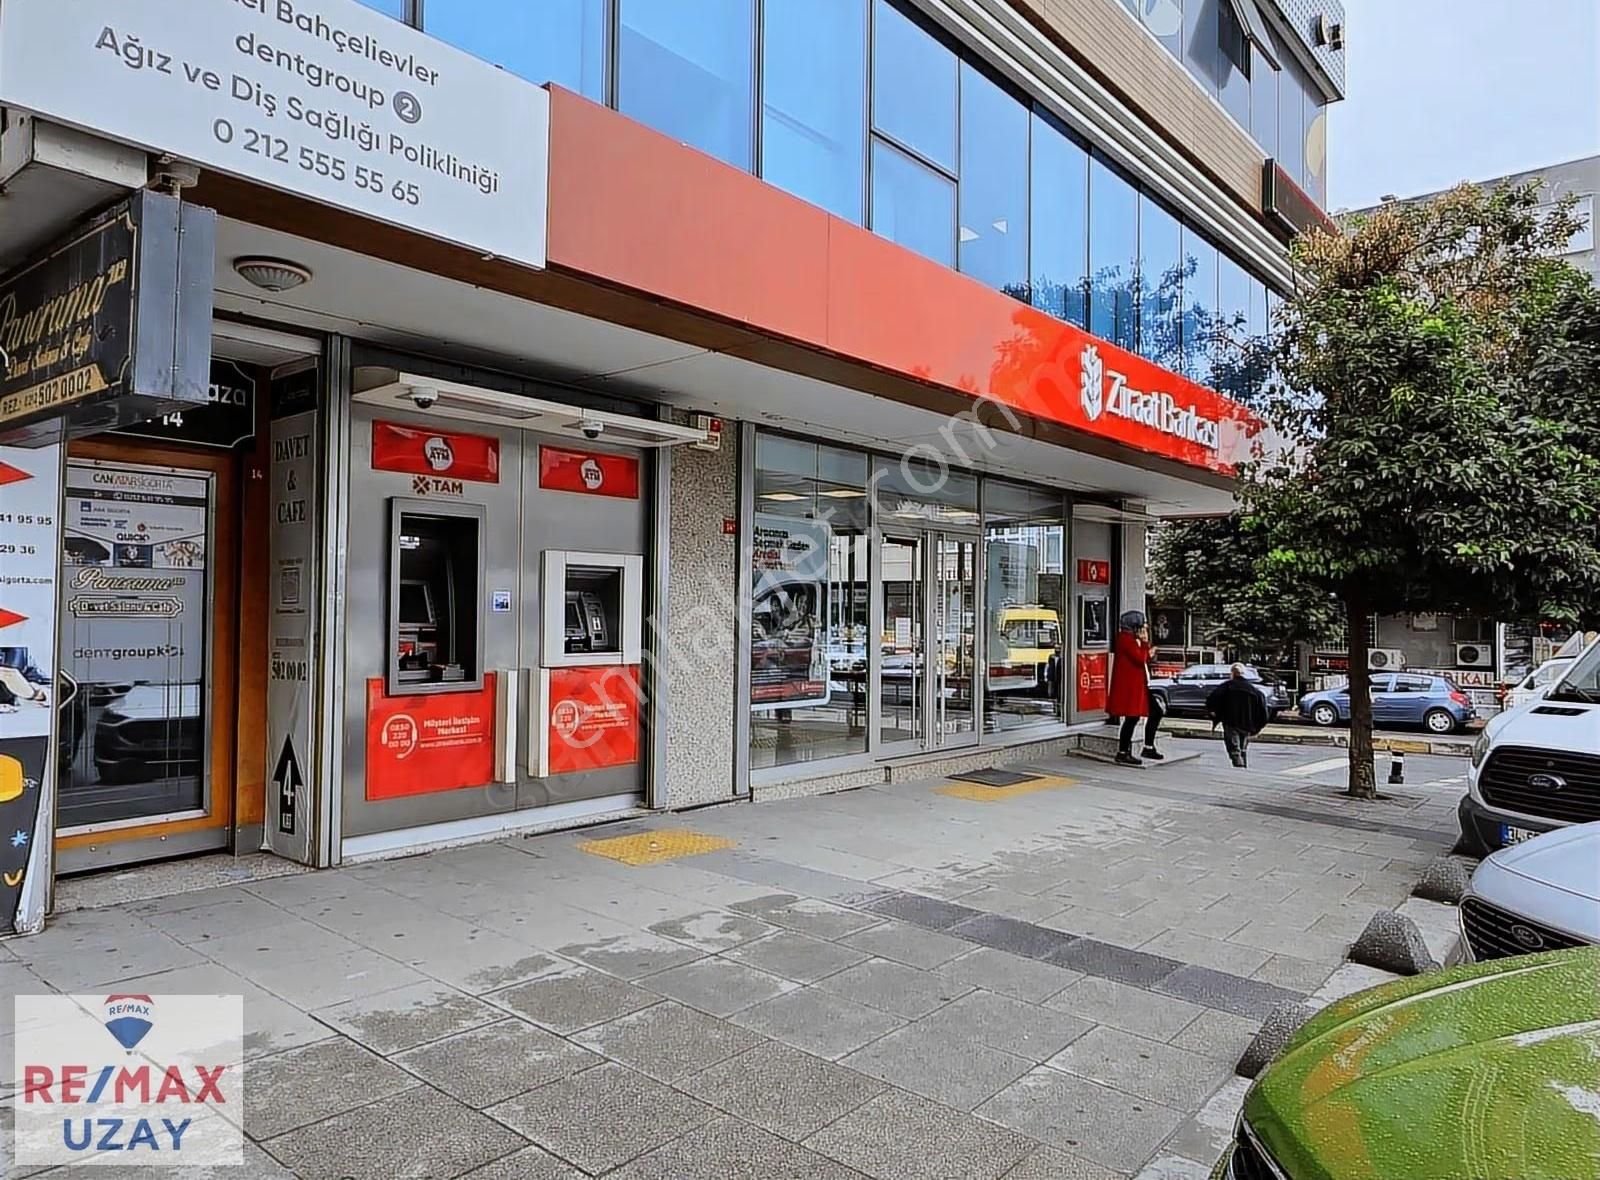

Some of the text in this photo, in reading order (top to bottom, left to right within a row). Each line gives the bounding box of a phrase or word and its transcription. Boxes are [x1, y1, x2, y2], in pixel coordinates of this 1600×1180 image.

[276, 0, 439, 85] Bahçelievler
[235, 32, 385, 109] dentgroup
[95, 26, 499, 194] Ağız ve Diş Sağlığı Polikliniği
[243, 128, 290, 163] 212
[298, 146, 346, 181] 555
[354, 165, 384, 193] 55
[391, 180, 420, 205] 65
[38, 381, 59, 406] 502
[60, 374, 75, 399] 00
[76, 368, 92, 393] 02
[208, 384, 246, 406] aza
[274, 435, 310, 462] DAVET
[430, 450, 451, 462] ATM
[287, 469, 297, 492] &
[431, 479, 463, 495] TAM
[17, 514, 33, 524] 95
[36, 516, 53, 526] 95
[277, 500, 306, 524] CAFE
[70, 566, 172, 591] Panorama
